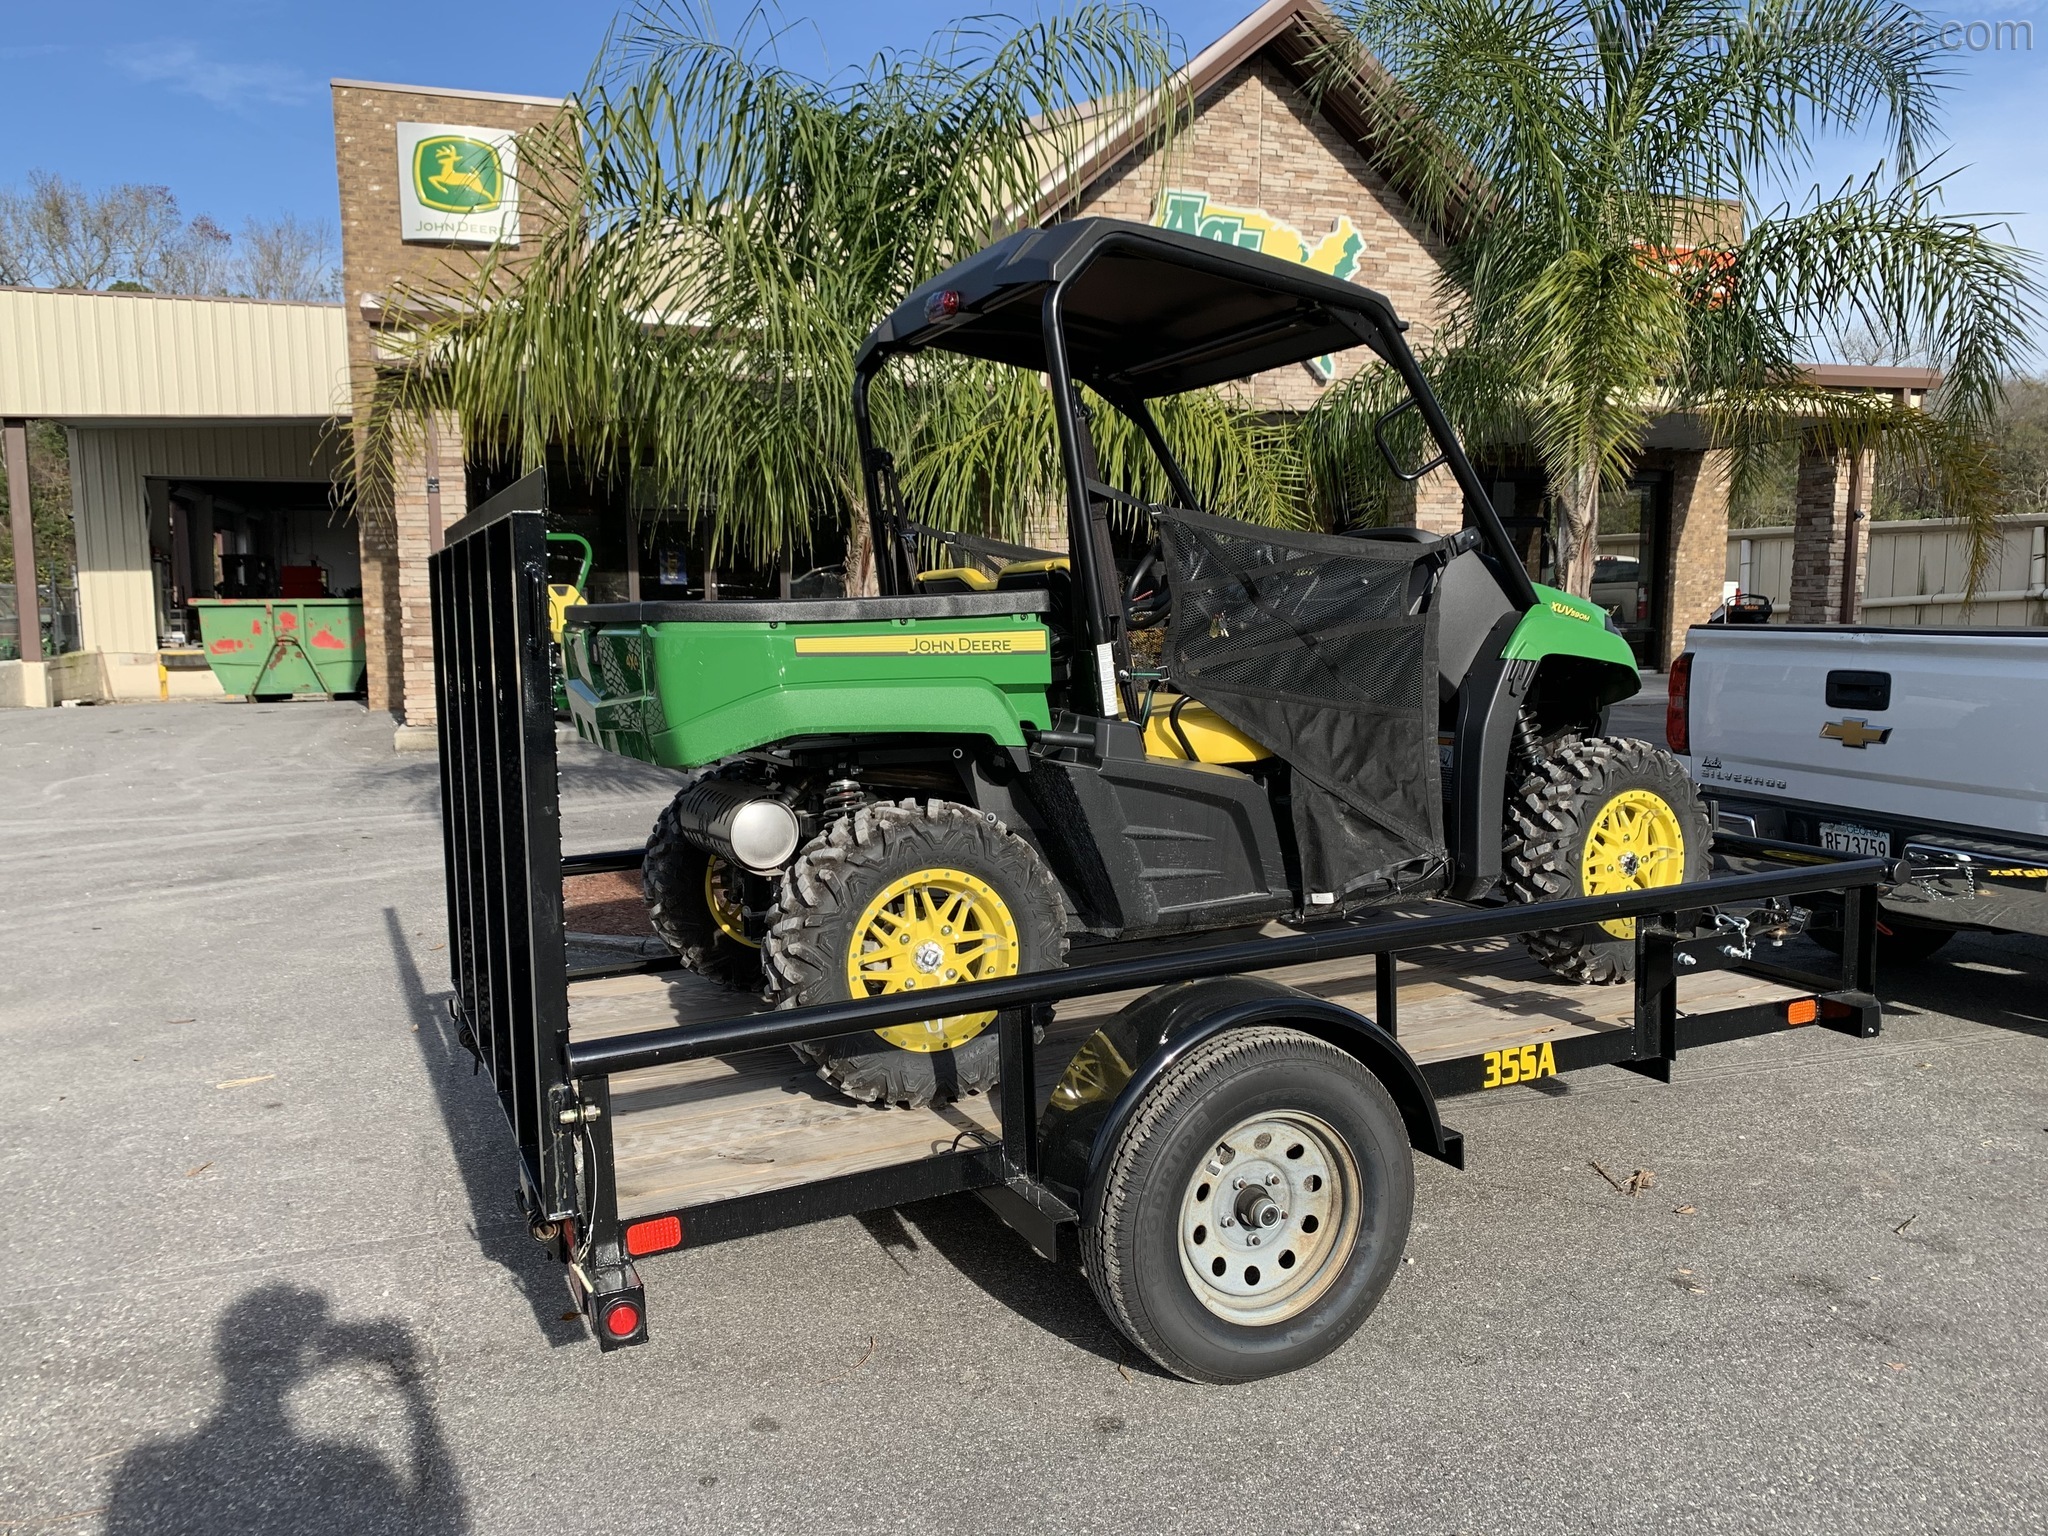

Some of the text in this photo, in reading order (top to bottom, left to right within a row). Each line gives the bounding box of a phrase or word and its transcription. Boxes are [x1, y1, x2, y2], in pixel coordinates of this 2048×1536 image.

[415, 221, 454, 232] JOHN
[909, 638, 1011, 652] JOHN DEERE
[1483, 1041, 1557, 1088] 35SA
